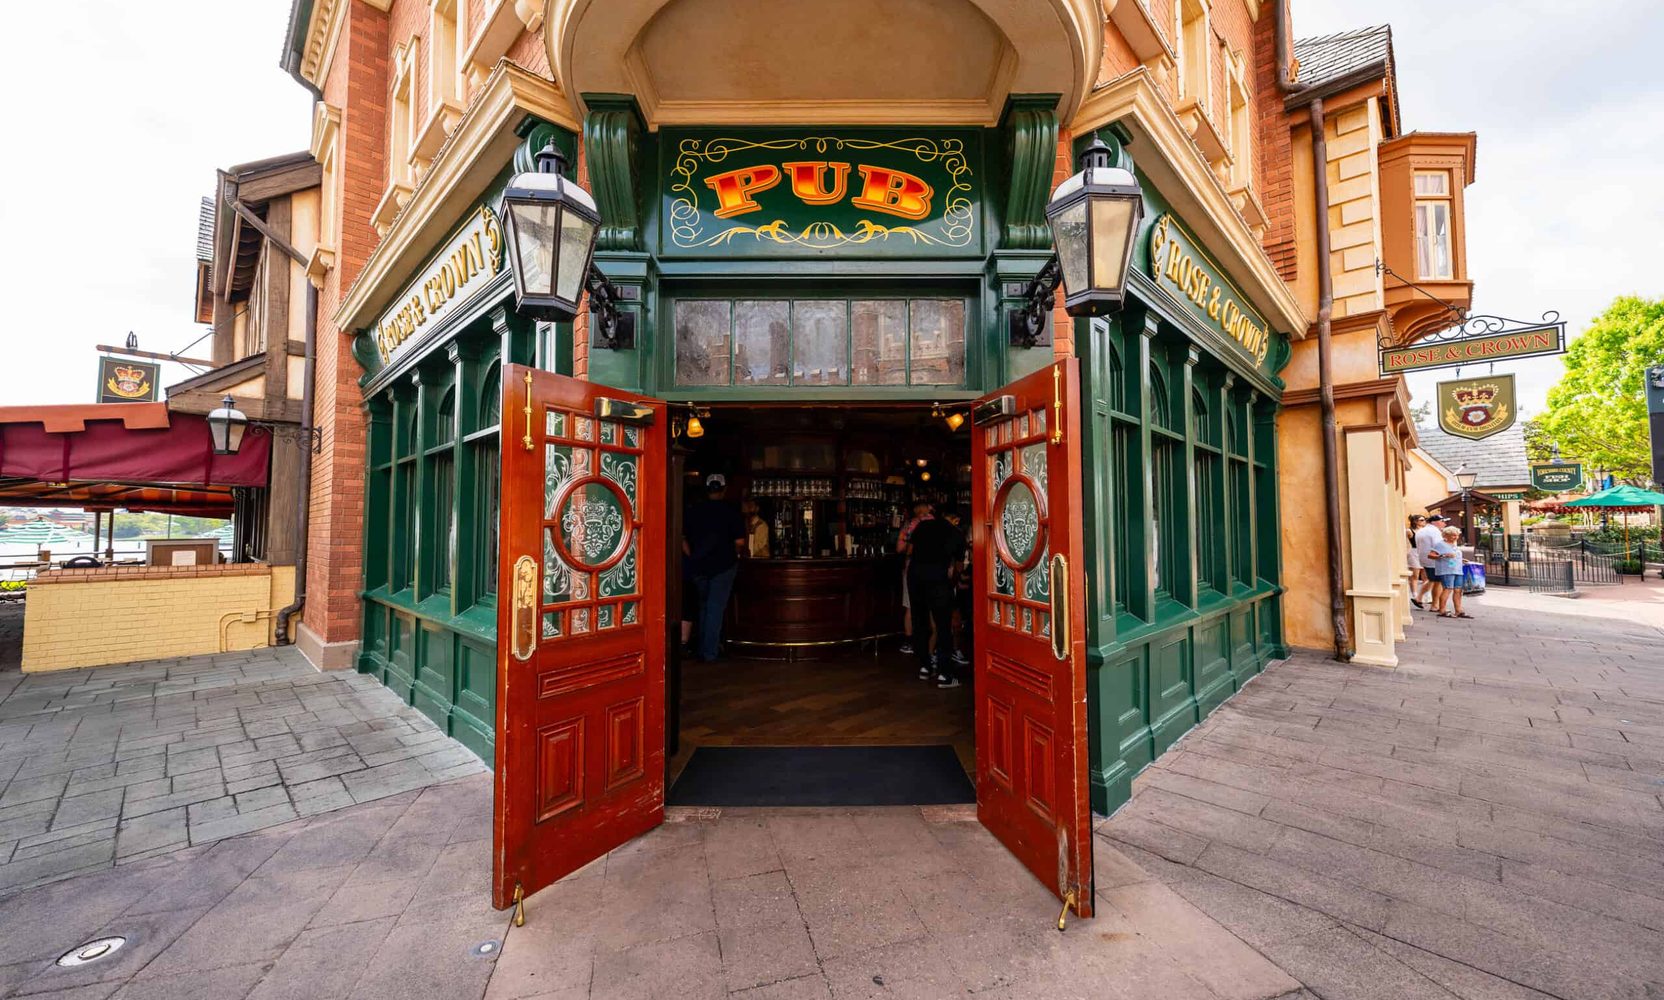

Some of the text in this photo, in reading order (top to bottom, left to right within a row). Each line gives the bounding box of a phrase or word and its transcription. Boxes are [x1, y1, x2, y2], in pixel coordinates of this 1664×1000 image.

[704, 161, 934, 220] PUB
[384, 231, 484, 352] ROSE & CROWN
[1165, 239, 1262, 356] ROSE & CROWN
[1389, 332, 1550, 368] ROSE & CROWN
